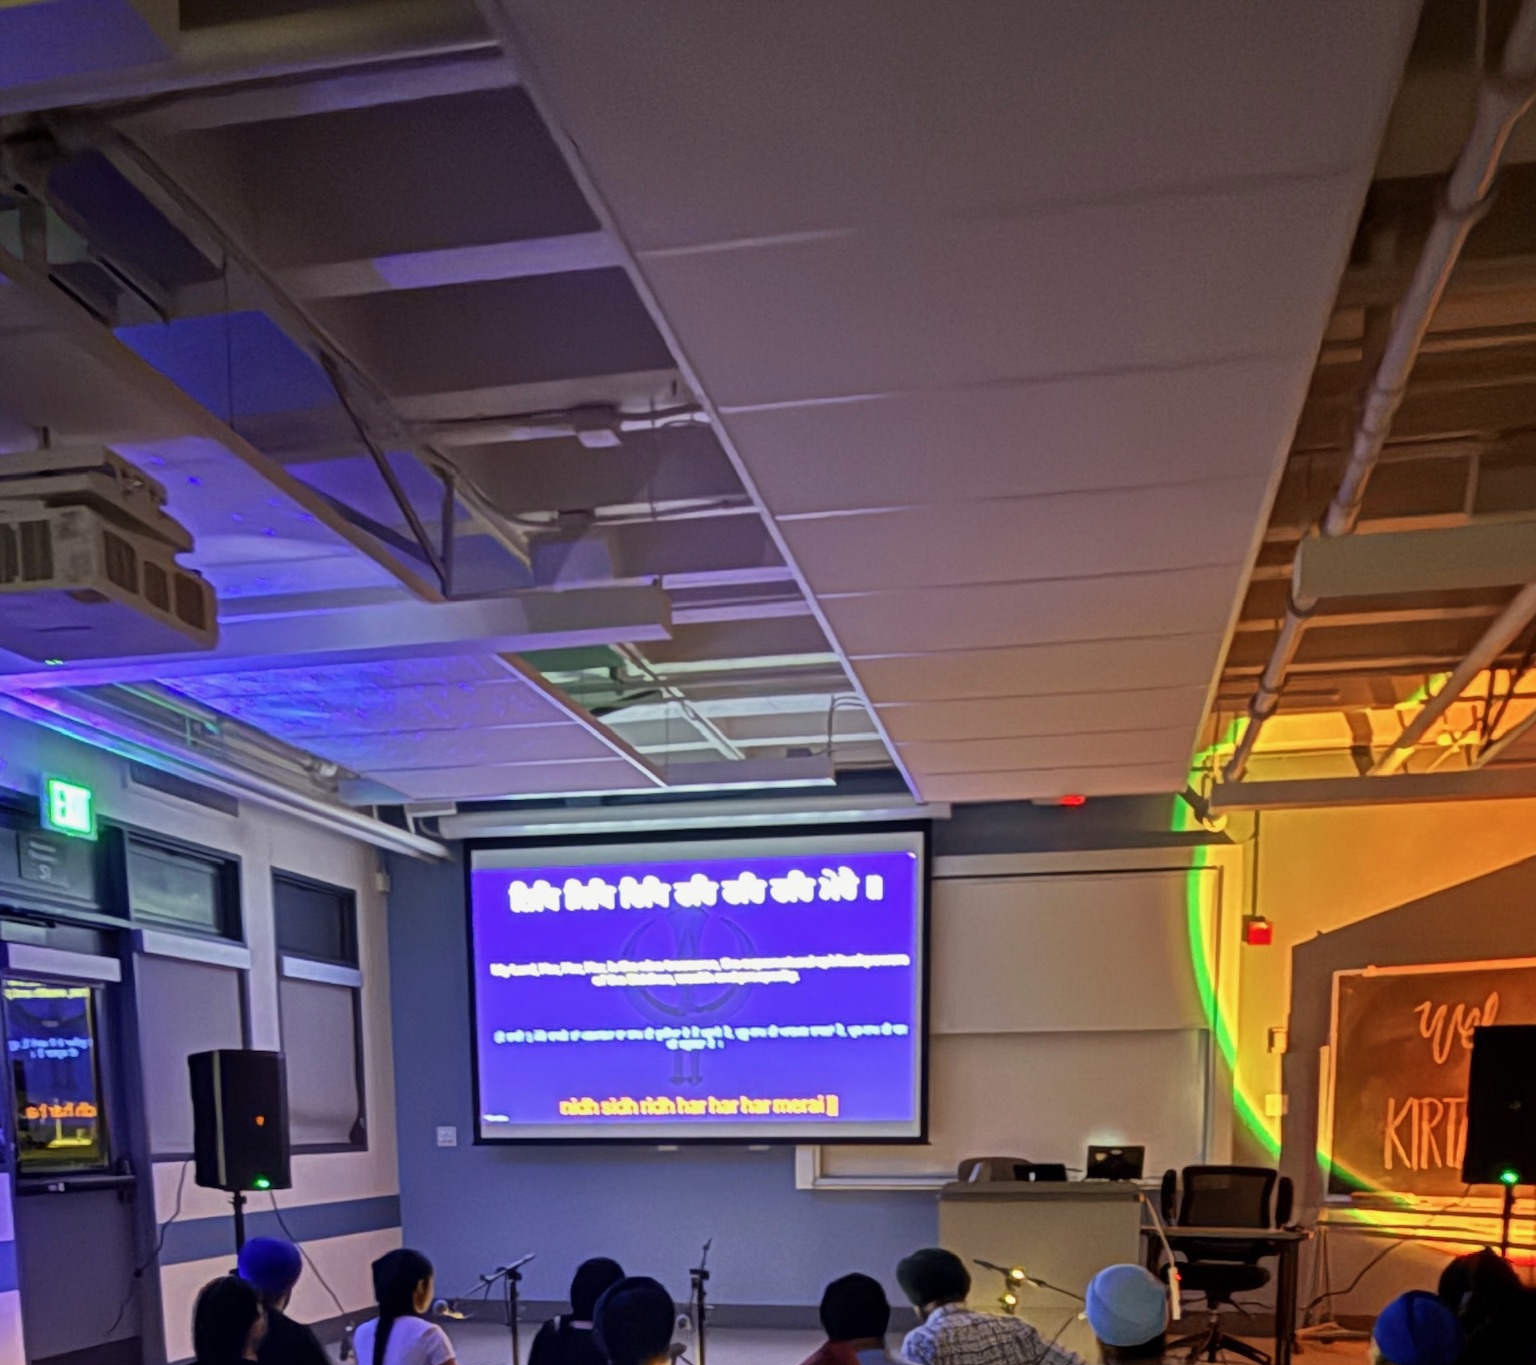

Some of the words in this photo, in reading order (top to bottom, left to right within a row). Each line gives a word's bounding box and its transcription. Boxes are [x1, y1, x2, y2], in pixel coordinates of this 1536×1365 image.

[676, 1096, 707, 1115] har
[708, 1096, 739, 1115] har
[740, 1095, 771, 1115] har
